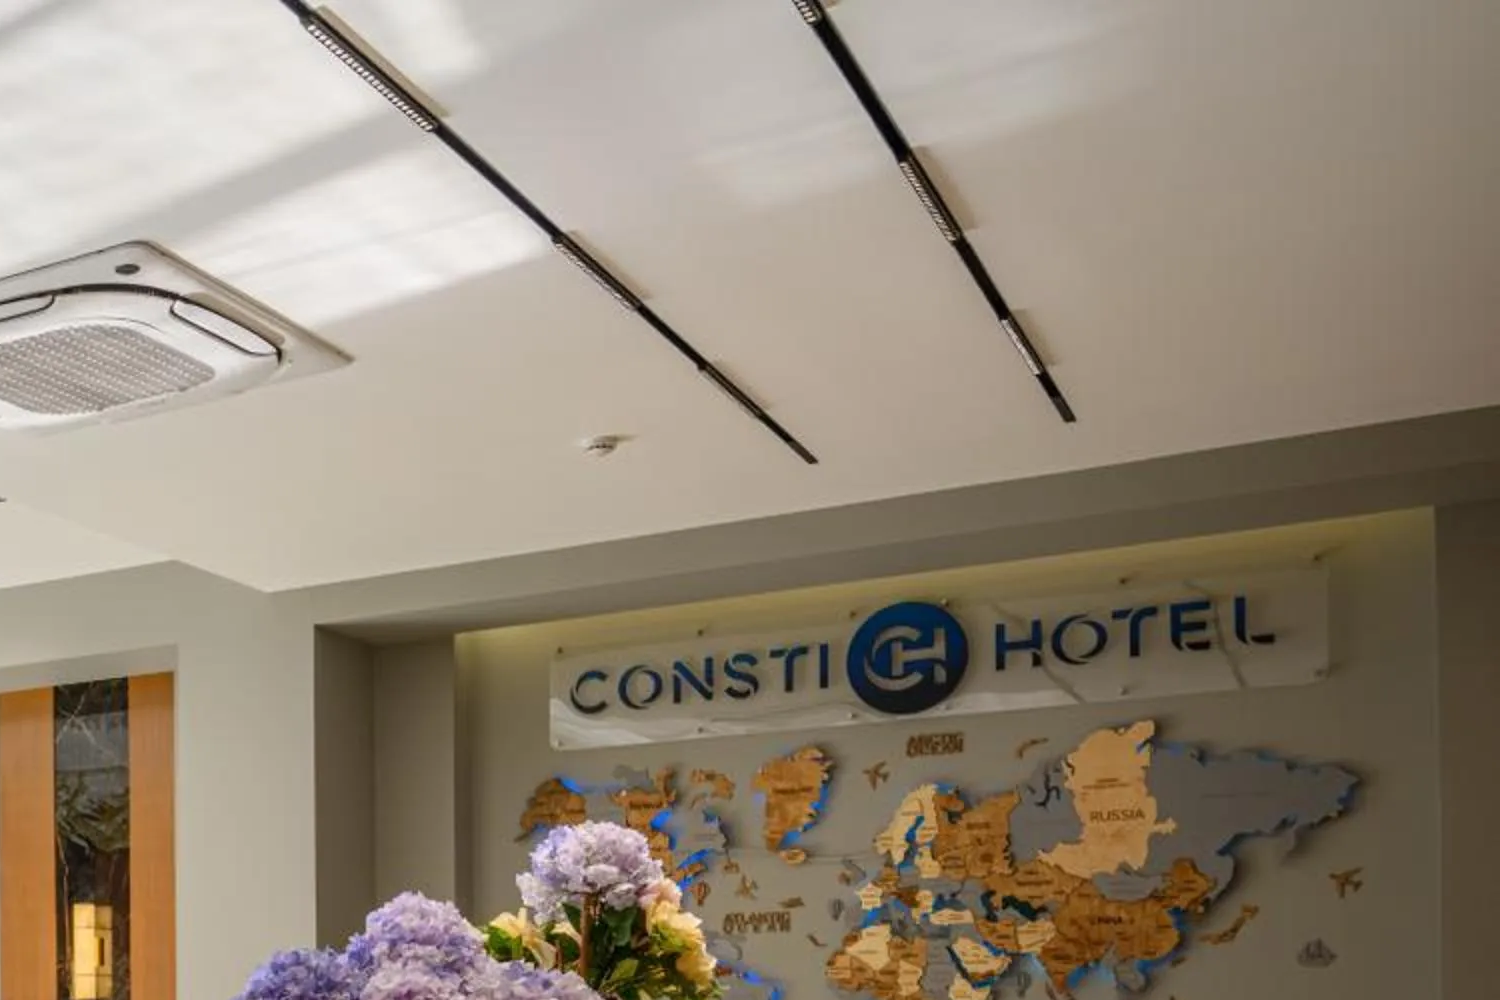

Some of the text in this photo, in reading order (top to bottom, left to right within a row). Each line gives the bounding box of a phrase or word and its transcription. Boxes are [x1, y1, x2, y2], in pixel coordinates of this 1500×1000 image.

[570, 643, 829, 714] CONSTI
[995, 596, 1276, 671] HOTEL
[1089, 808, 1145, 823] RUSSIA
